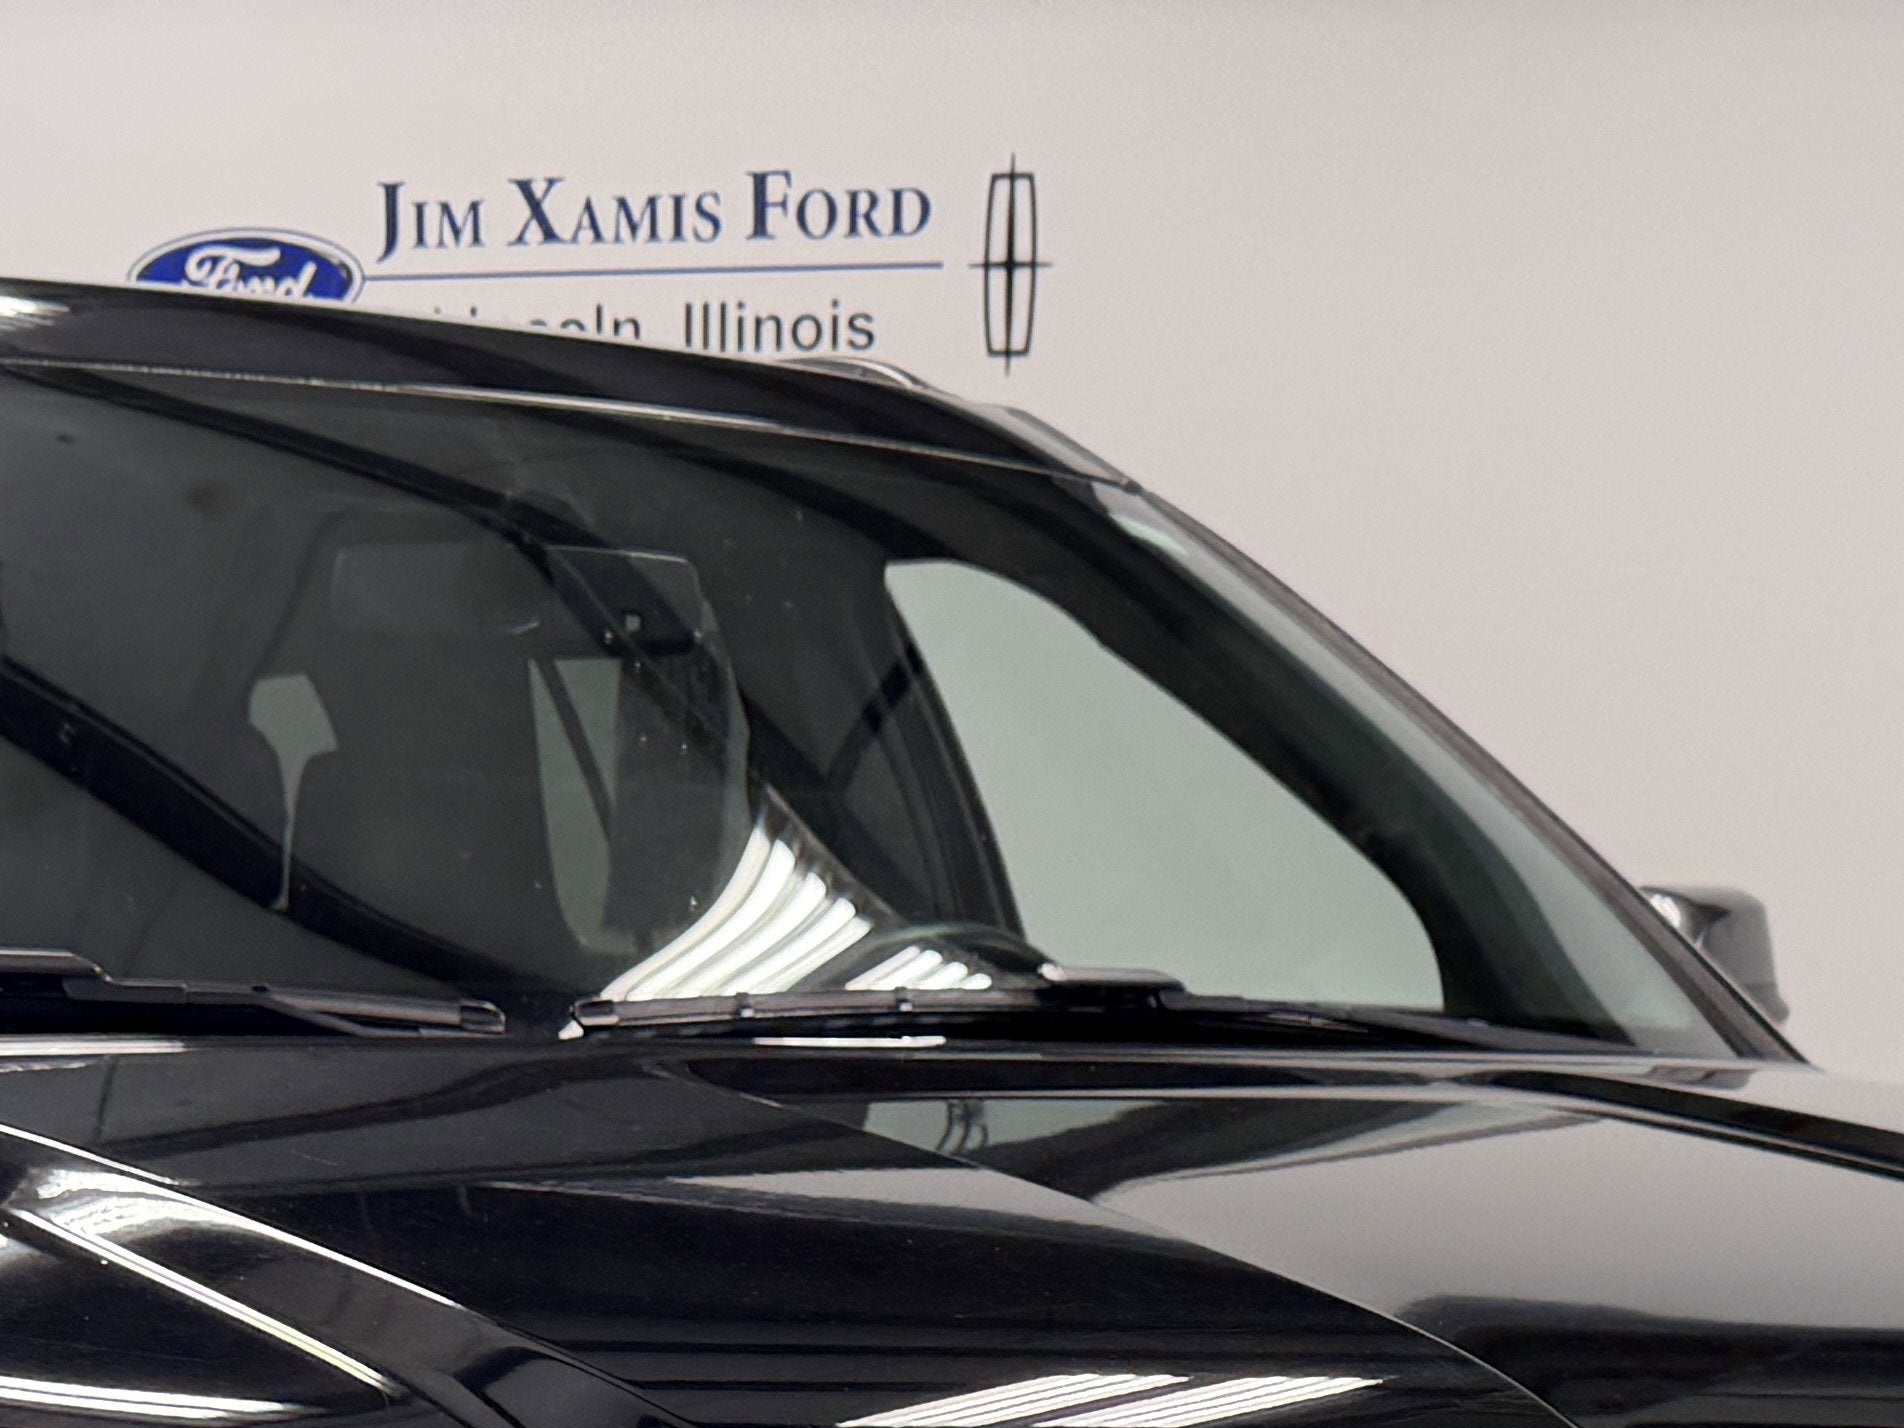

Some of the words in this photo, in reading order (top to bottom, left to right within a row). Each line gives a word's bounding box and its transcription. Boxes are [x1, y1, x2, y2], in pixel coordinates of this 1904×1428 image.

[376, 181, 484, 263] JIM
[507, 176, 723, 248] XAMIS
[746, 169, 933, 241] FORD
[684, 298, 877, 352] Illinois
